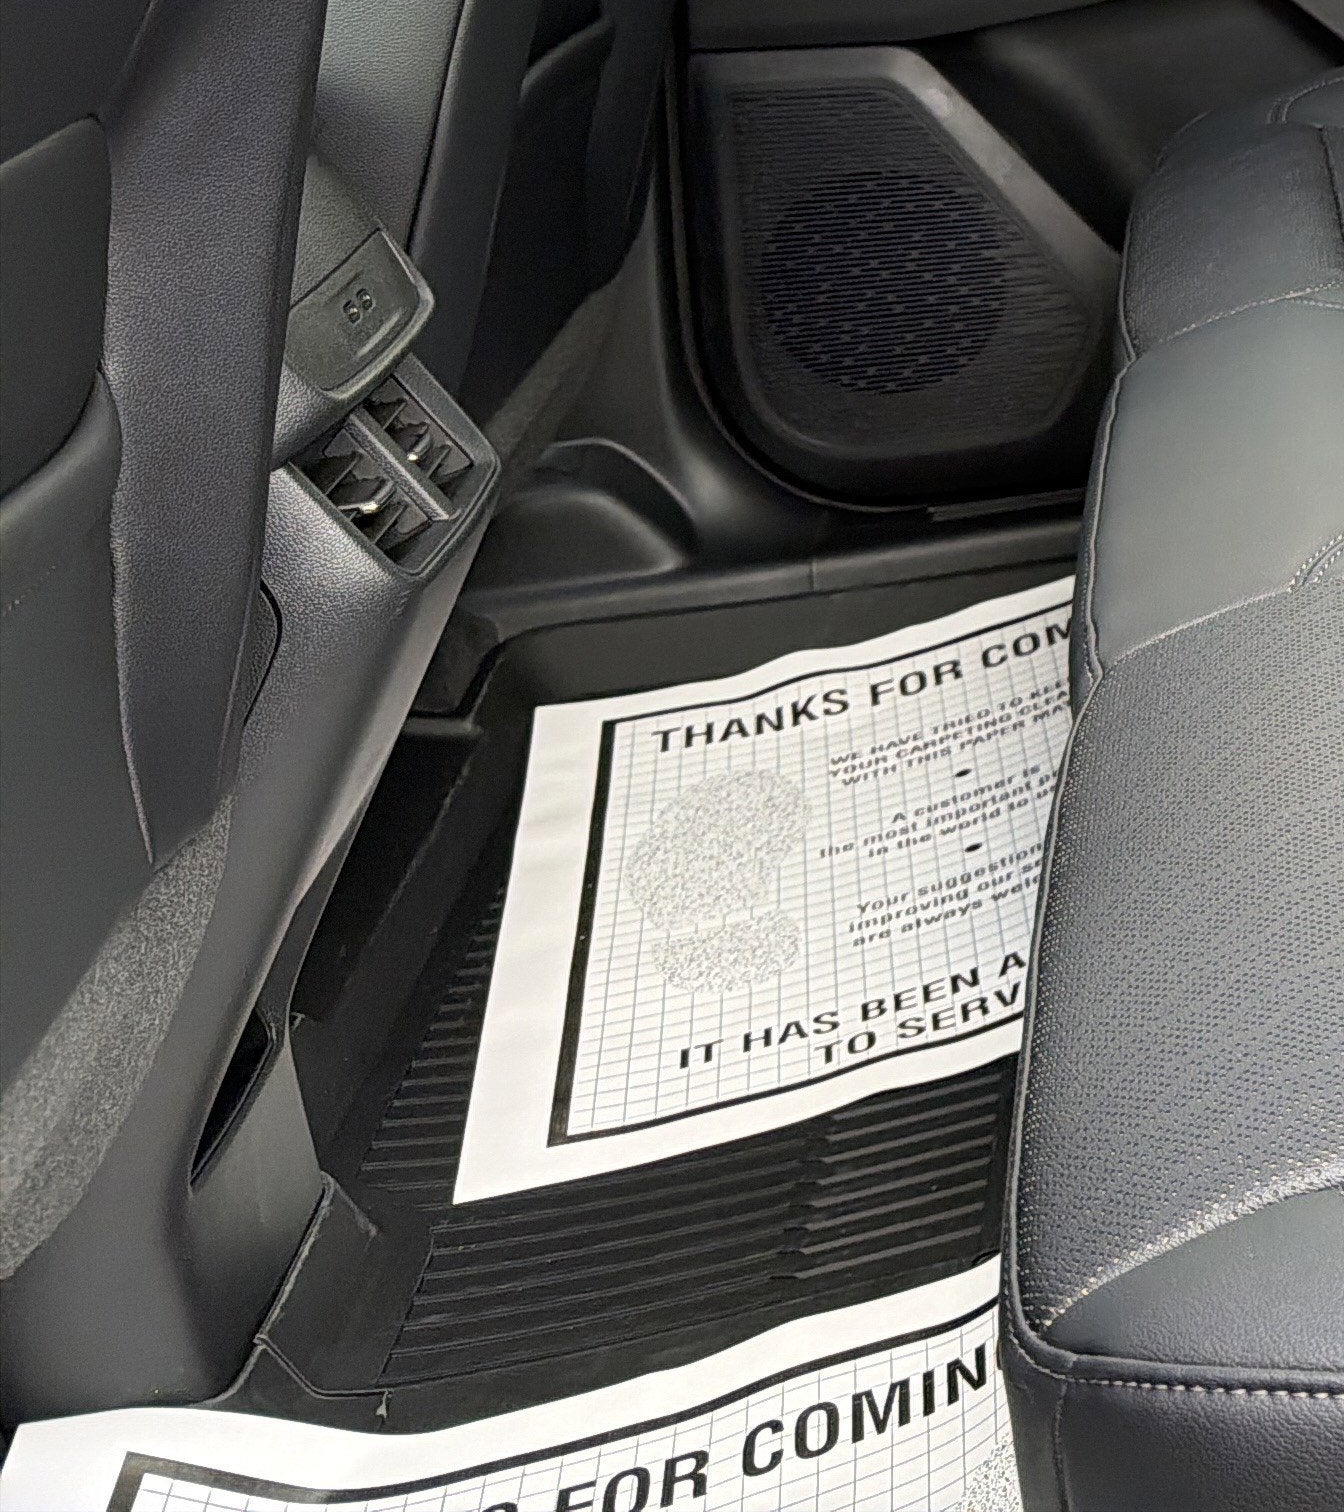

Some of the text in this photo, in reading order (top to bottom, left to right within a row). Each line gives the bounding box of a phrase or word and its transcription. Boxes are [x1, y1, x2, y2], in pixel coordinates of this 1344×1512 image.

[652, 617, 1071, 753] THANKS FOR COM
[831, 679, 1063, 766] WE HAVE TRIED TO KEE
[829, 690, 1068, 778] YOUR CARPETING CLEA
[841, 763, 897, 786] WITH
[905, 745, 952, 769] THIS
[960, 719, 1026, 750] PAPER
[820, 780, 1032, 859] the most important
[868, 845, 889, 858] in
[897, 832, 932, 850] the
[939, 807, 1001, 837] world
[1007, 797, 1029, 812] to
[891, 811, 907, 824] A
[914, 774, 1018, 817] customer
[1022, 764, 1041, 779] is
[849, 870, 1014, 934] improving our
[853, 872, 1041, 948] are always welc
[857, 890, 911, 915] Your
[917, 842, 1042, 898] suggestion
[679, 951, 1028, 1070] IT HAS BEEN A
[813, 981, 1023, 1066] TO SERV
[555, 1341, 988, 1512] FOR COMIN
